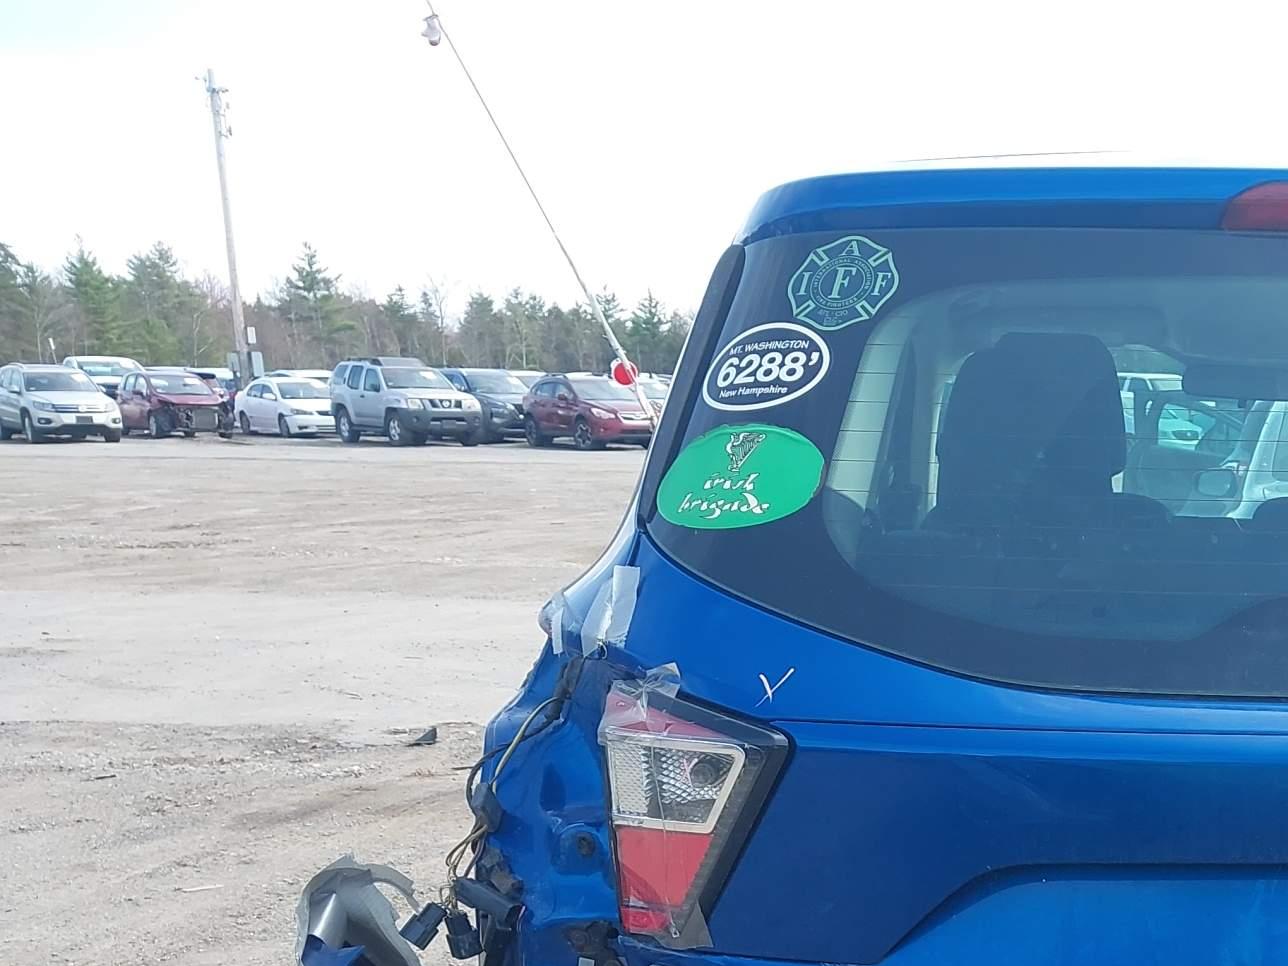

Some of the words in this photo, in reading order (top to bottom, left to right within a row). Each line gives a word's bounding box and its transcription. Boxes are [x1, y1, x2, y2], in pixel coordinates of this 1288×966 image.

[839, 240, 861, 256] A
[827, 267, 857, 299] F
[871, 271, 892, 296] F
[729, 345, 743, 356] MT.
[744, 339, 810, 353] WASHINGTON
[718, 389, 738, 399] New
[738, 384, 789, 398] Hampshire
